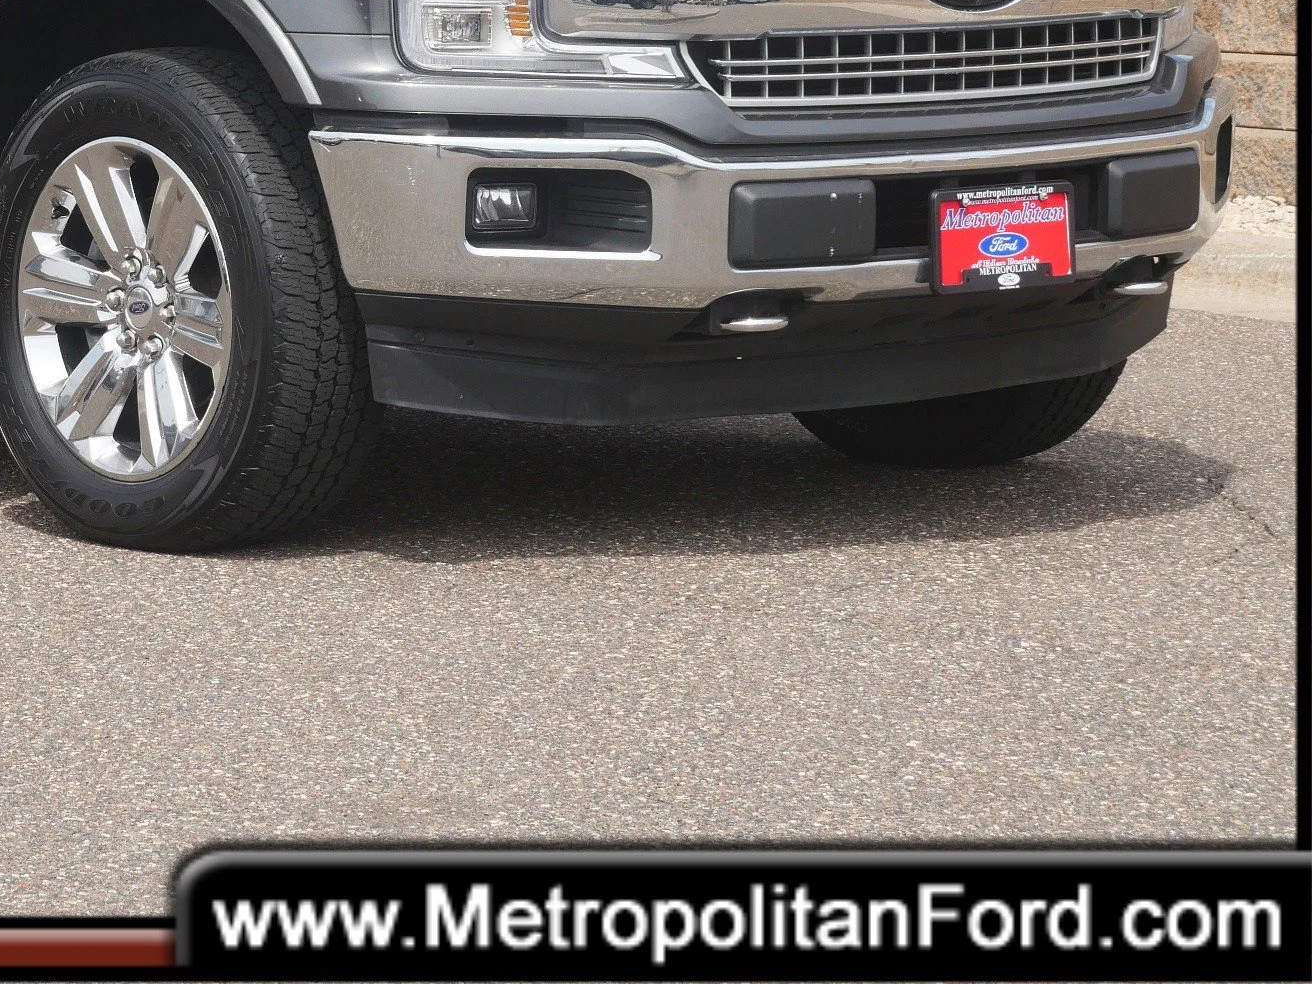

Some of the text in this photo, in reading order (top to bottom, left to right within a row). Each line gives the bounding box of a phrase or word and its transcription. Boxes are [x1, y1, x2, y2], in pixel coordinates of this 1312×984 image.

[957, 185, 1054, 200] www.metropolitanford.com
[940, 201, 1064, 232] Metropolitan
[989, 236, 1018, 252] Ford
[979, 263, 1038, 276] METROPOLITAN
